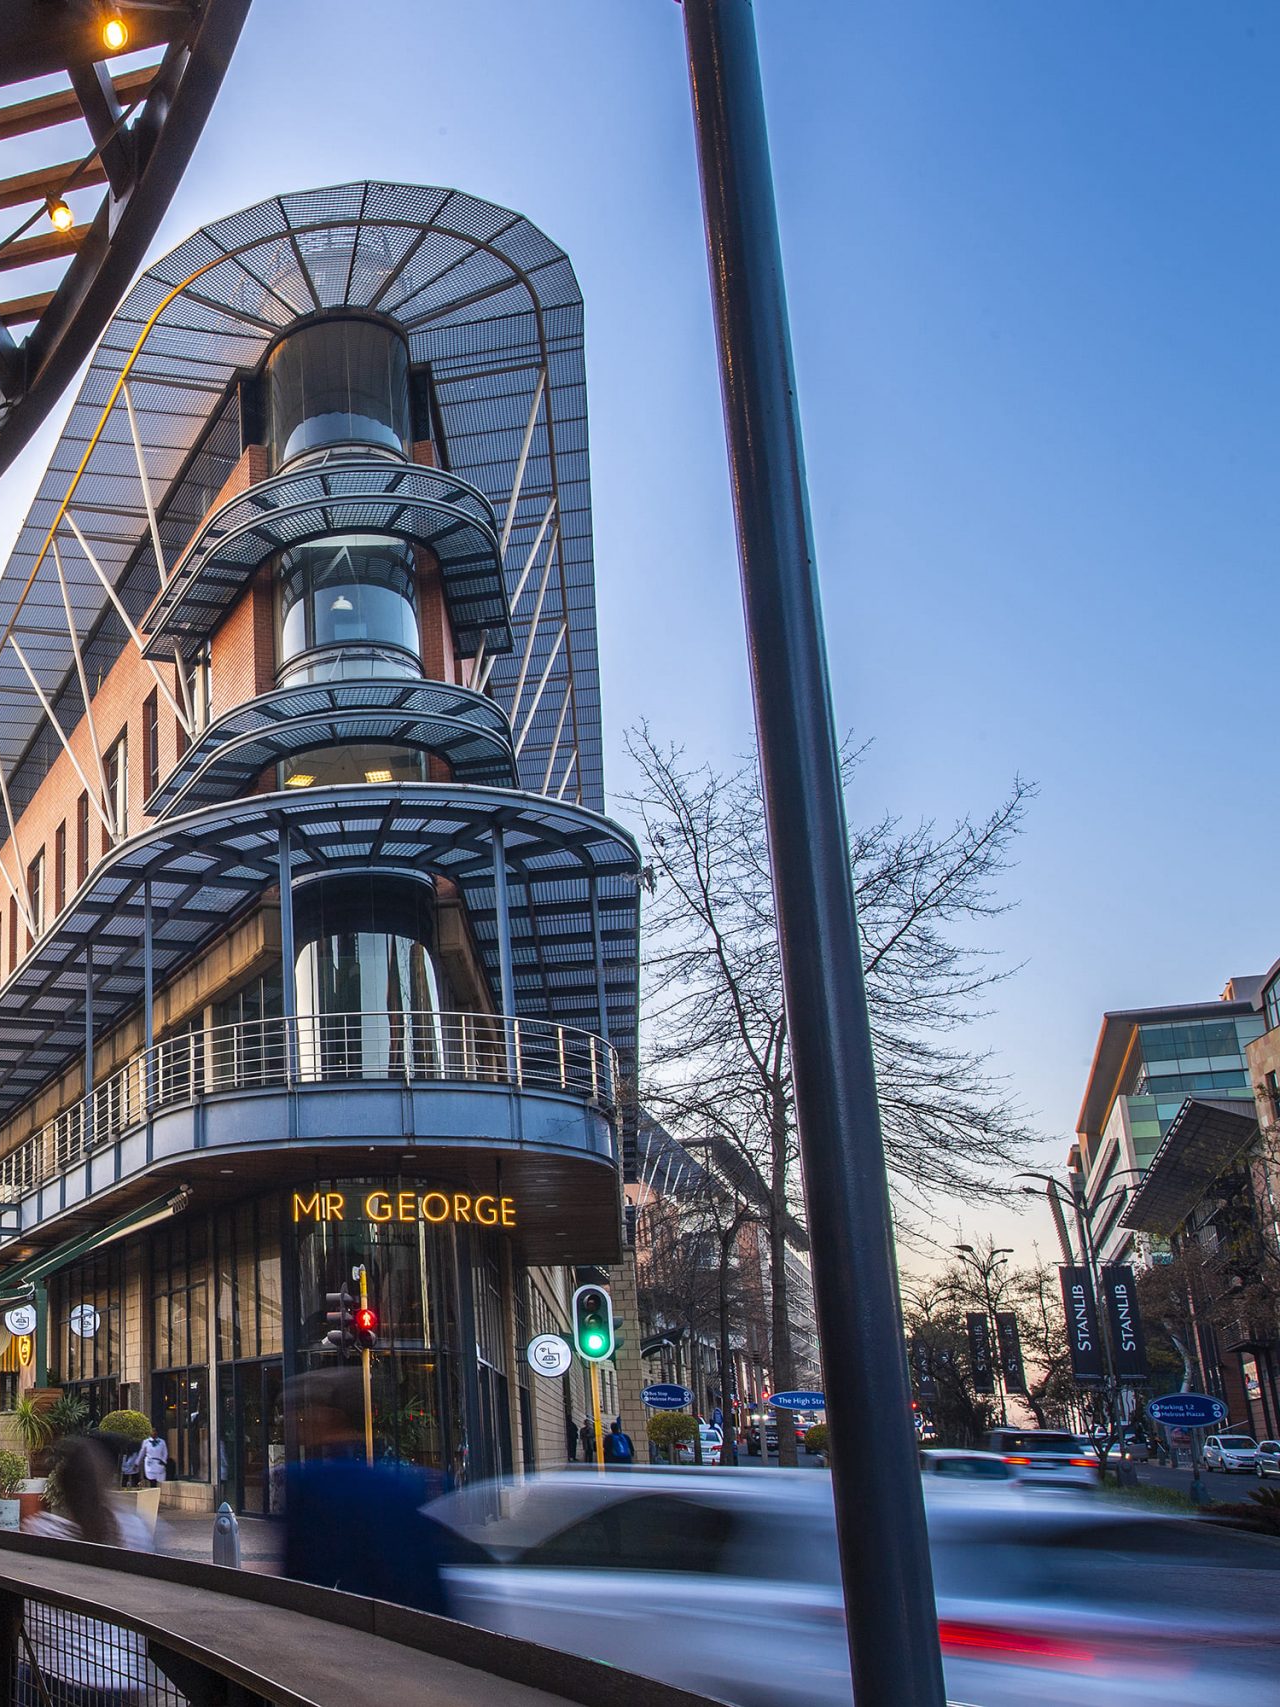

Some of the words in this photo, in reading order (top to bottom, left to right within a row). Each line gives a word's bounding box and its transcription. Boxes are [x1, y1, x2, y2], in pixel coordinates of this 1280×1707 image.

[293, 1192, 344, 1223] MR
[365, 1191, 516, 1226] GEORGE
[1072, 1284, 1092, 1351] STANLIB
[1114, 1284, 1136, 1351] STANLIB
[793, 1397, 810, 1406] High
